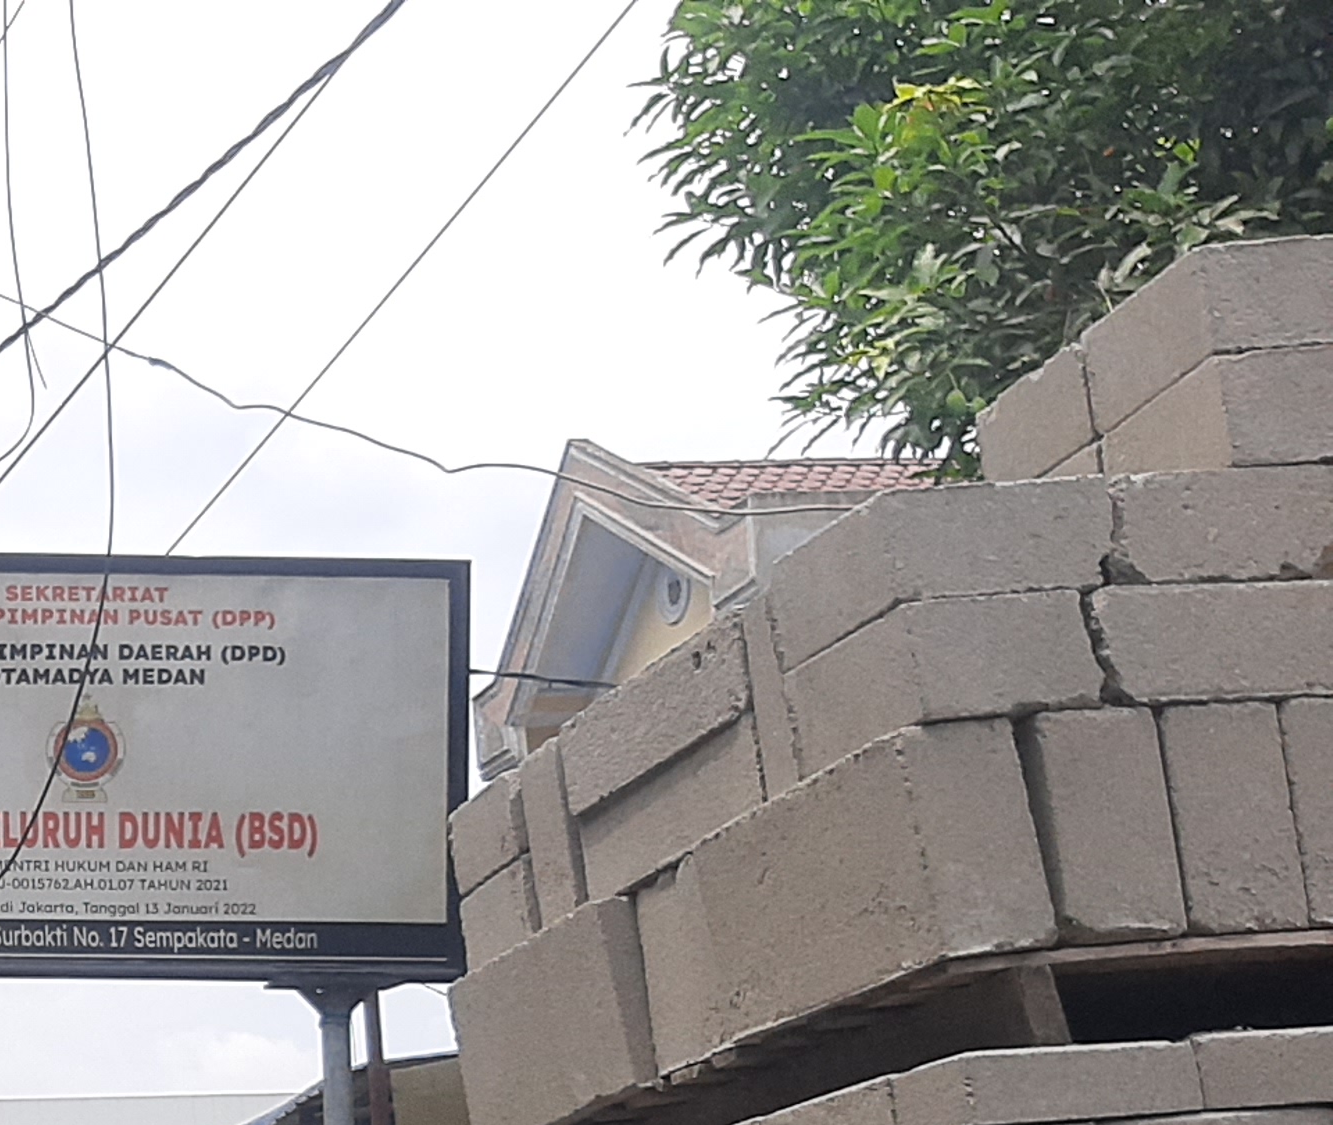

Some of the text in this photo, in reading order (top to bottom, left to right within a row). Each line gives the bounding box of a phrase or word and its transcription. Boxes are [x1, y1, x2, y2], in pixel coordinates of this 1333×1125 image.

[5, 585, 169, 603] SEKRETARIAT
[127, 609, 203, 626] PUSAT
[212, 610, 276, 630] (DPP)
[118, 644, 212, 661] DAERAH
[221, 645, 286, 665] (DPD)
[122, 668, 205, 685] MEDAN
[118, 811, 225, 849] DUNIA
[235, 811, 318, 858] (BSD)
[54, 860, 111, 873] HUKUM
[115, 861, 148, 873] DAN
[153, 861, 187, 873] HAM
[192, 861, 209, 873] RI
[139, 878, 191, 891] TAHUN
[196, 878, 229, 891] 2021
[0, 900, 13, 913] di
[18, 901, 78, 916] Jakarta,
[82, 902, 140, 917] Tanggal
[144, 902, 159, 914] 13
[163, 902, 219, 915] Januari
[223, 903, 257, 915] 2022
[73, 925, 104, 947] No.
[109, 926, 128, 947] 17
[134, 926, 238, 953] Sempakata
[256, 928, 318, 949] Medan
